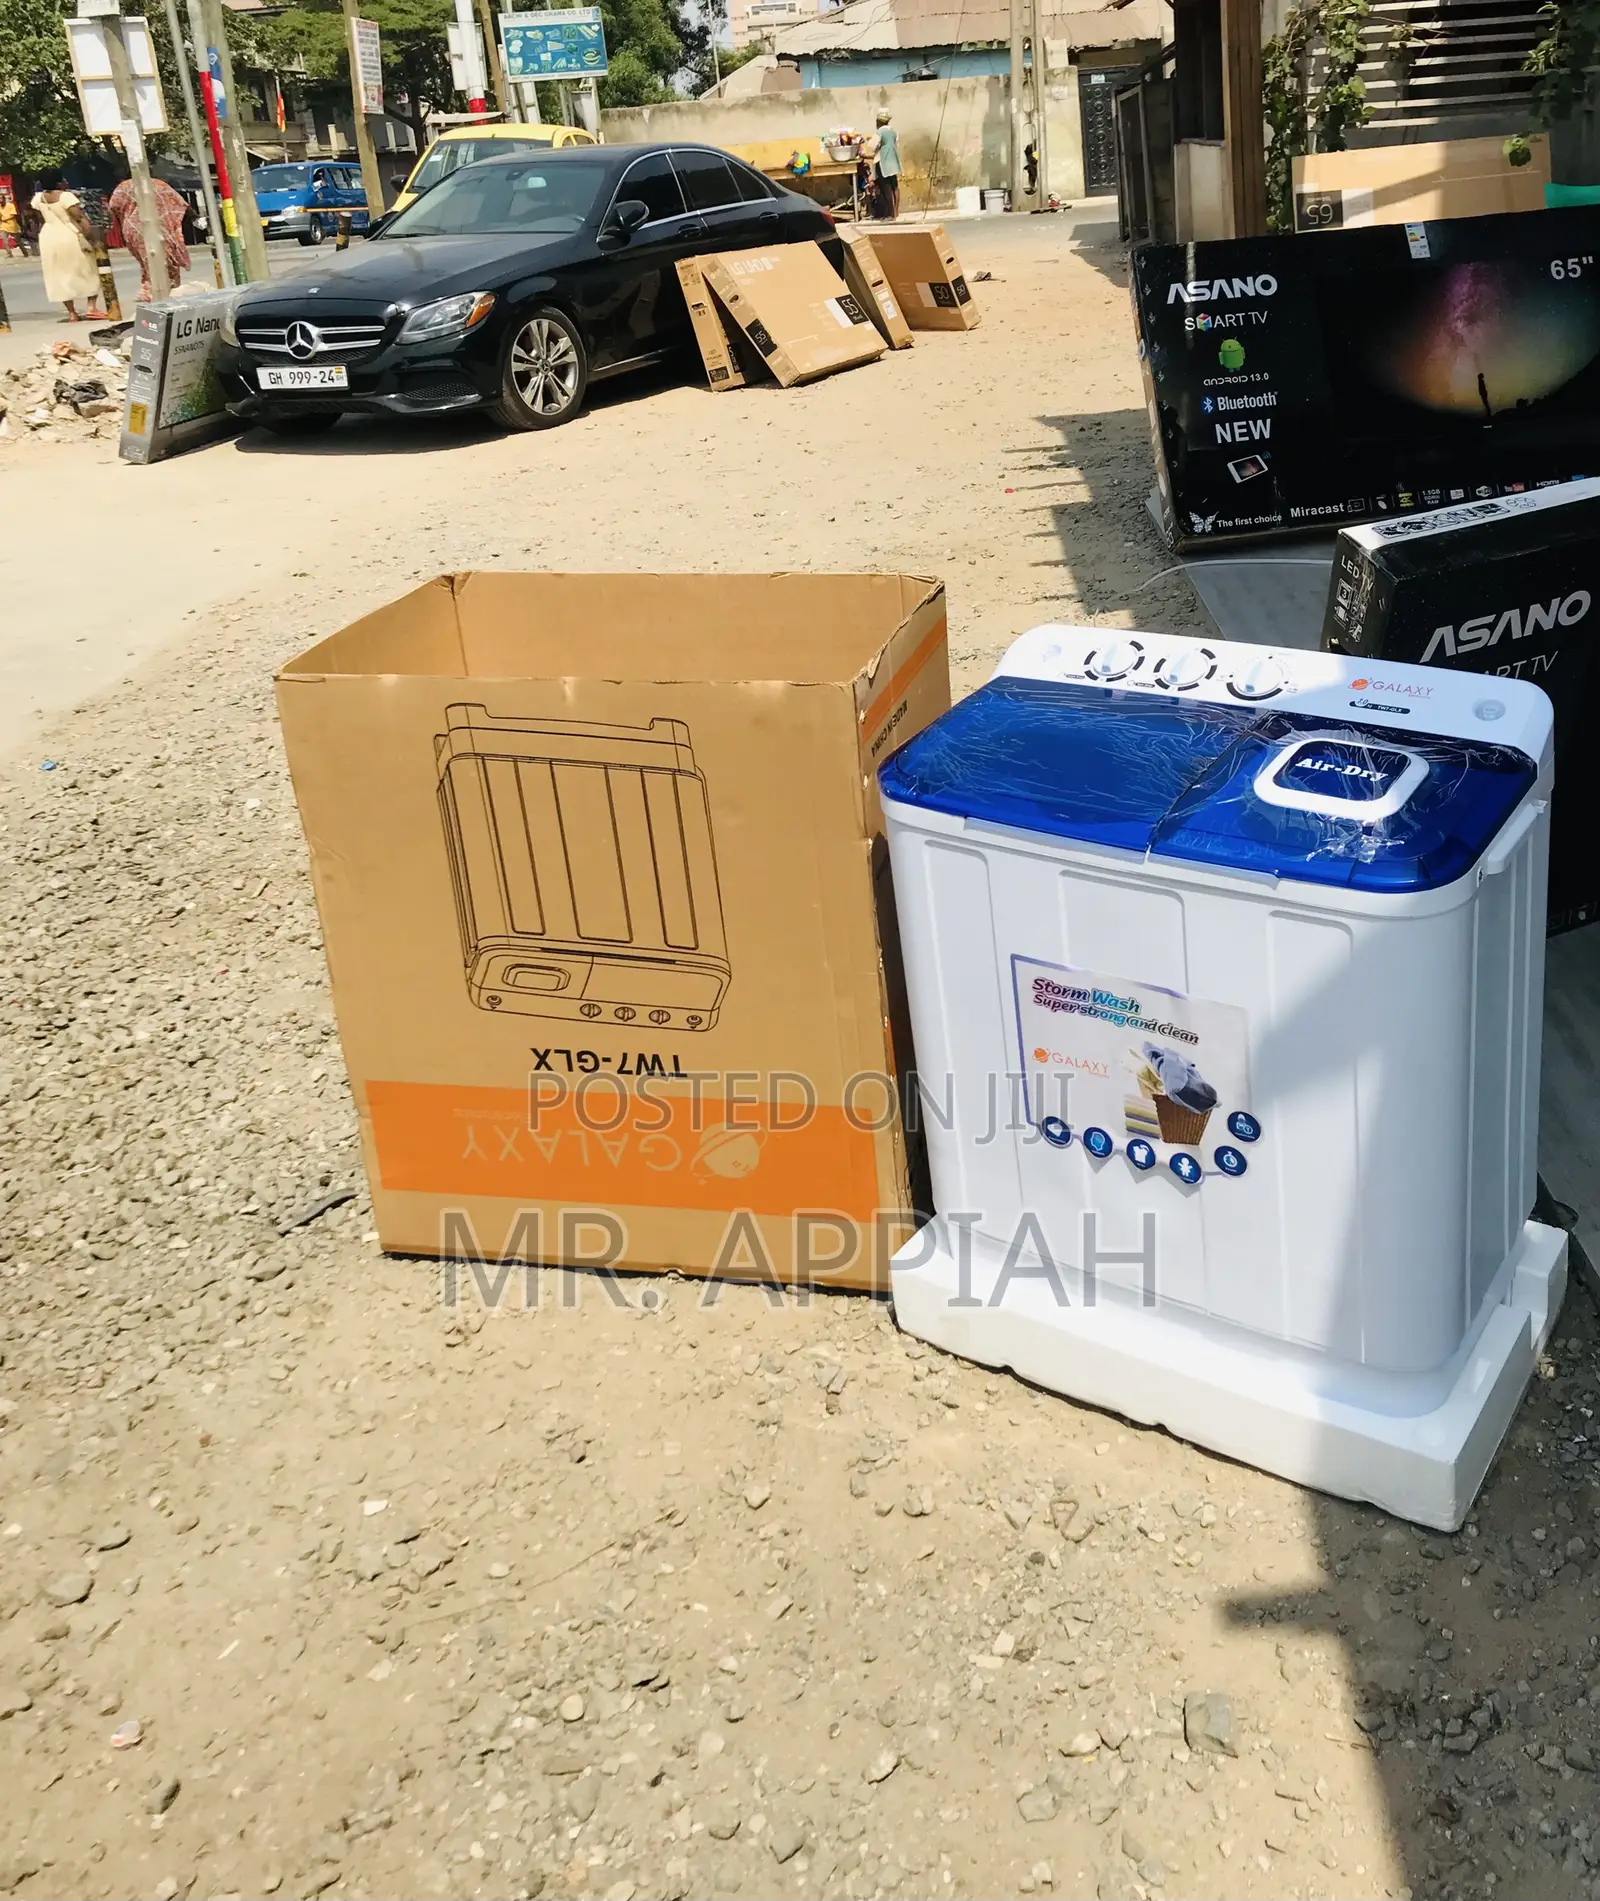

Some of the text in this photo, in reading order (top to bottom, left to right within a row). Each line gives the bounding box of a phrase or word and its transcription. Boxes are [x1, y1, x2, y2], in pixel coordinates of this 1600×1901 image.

[1306, 203, 1333, 225] 65
[1550, 255, 1594, 280] 65"
[1166, 273, 1278, 305] ASANO
[841, 298, 859, 315] 55
[1248, 310, 1268, 325] TV
[176, 319, 193, 339] LG
[268, 372, 284, 385] GH
[1249, 372, 1270, 382] 13.0
[1216, 391, 1277, 411] Bluetooth
[1215, 418, 1272, 445] NEW
[1217, 513, 1282, 528] The first choice
[1290, 502, 1345, 518] Miracast
[1341, 554, 1360, 579] LED
[1419, 590, 1592, 664] ASANO
[1531, 650, 1559, 675] TV
[1372, 680, 1434, 697] GALAXY
[1295, 757, 1389, 782] Air-Dry
[1032, 977, 1141, 1015] Storm Wash
[1033, 993, 1200, 1045] Super strong and clean
[530, 1047, 688, 1078] TW7-GLX
[1052, 1052, 1110, 1075] GALAXY
[461, 1122, 682, 1172] GALAXY
